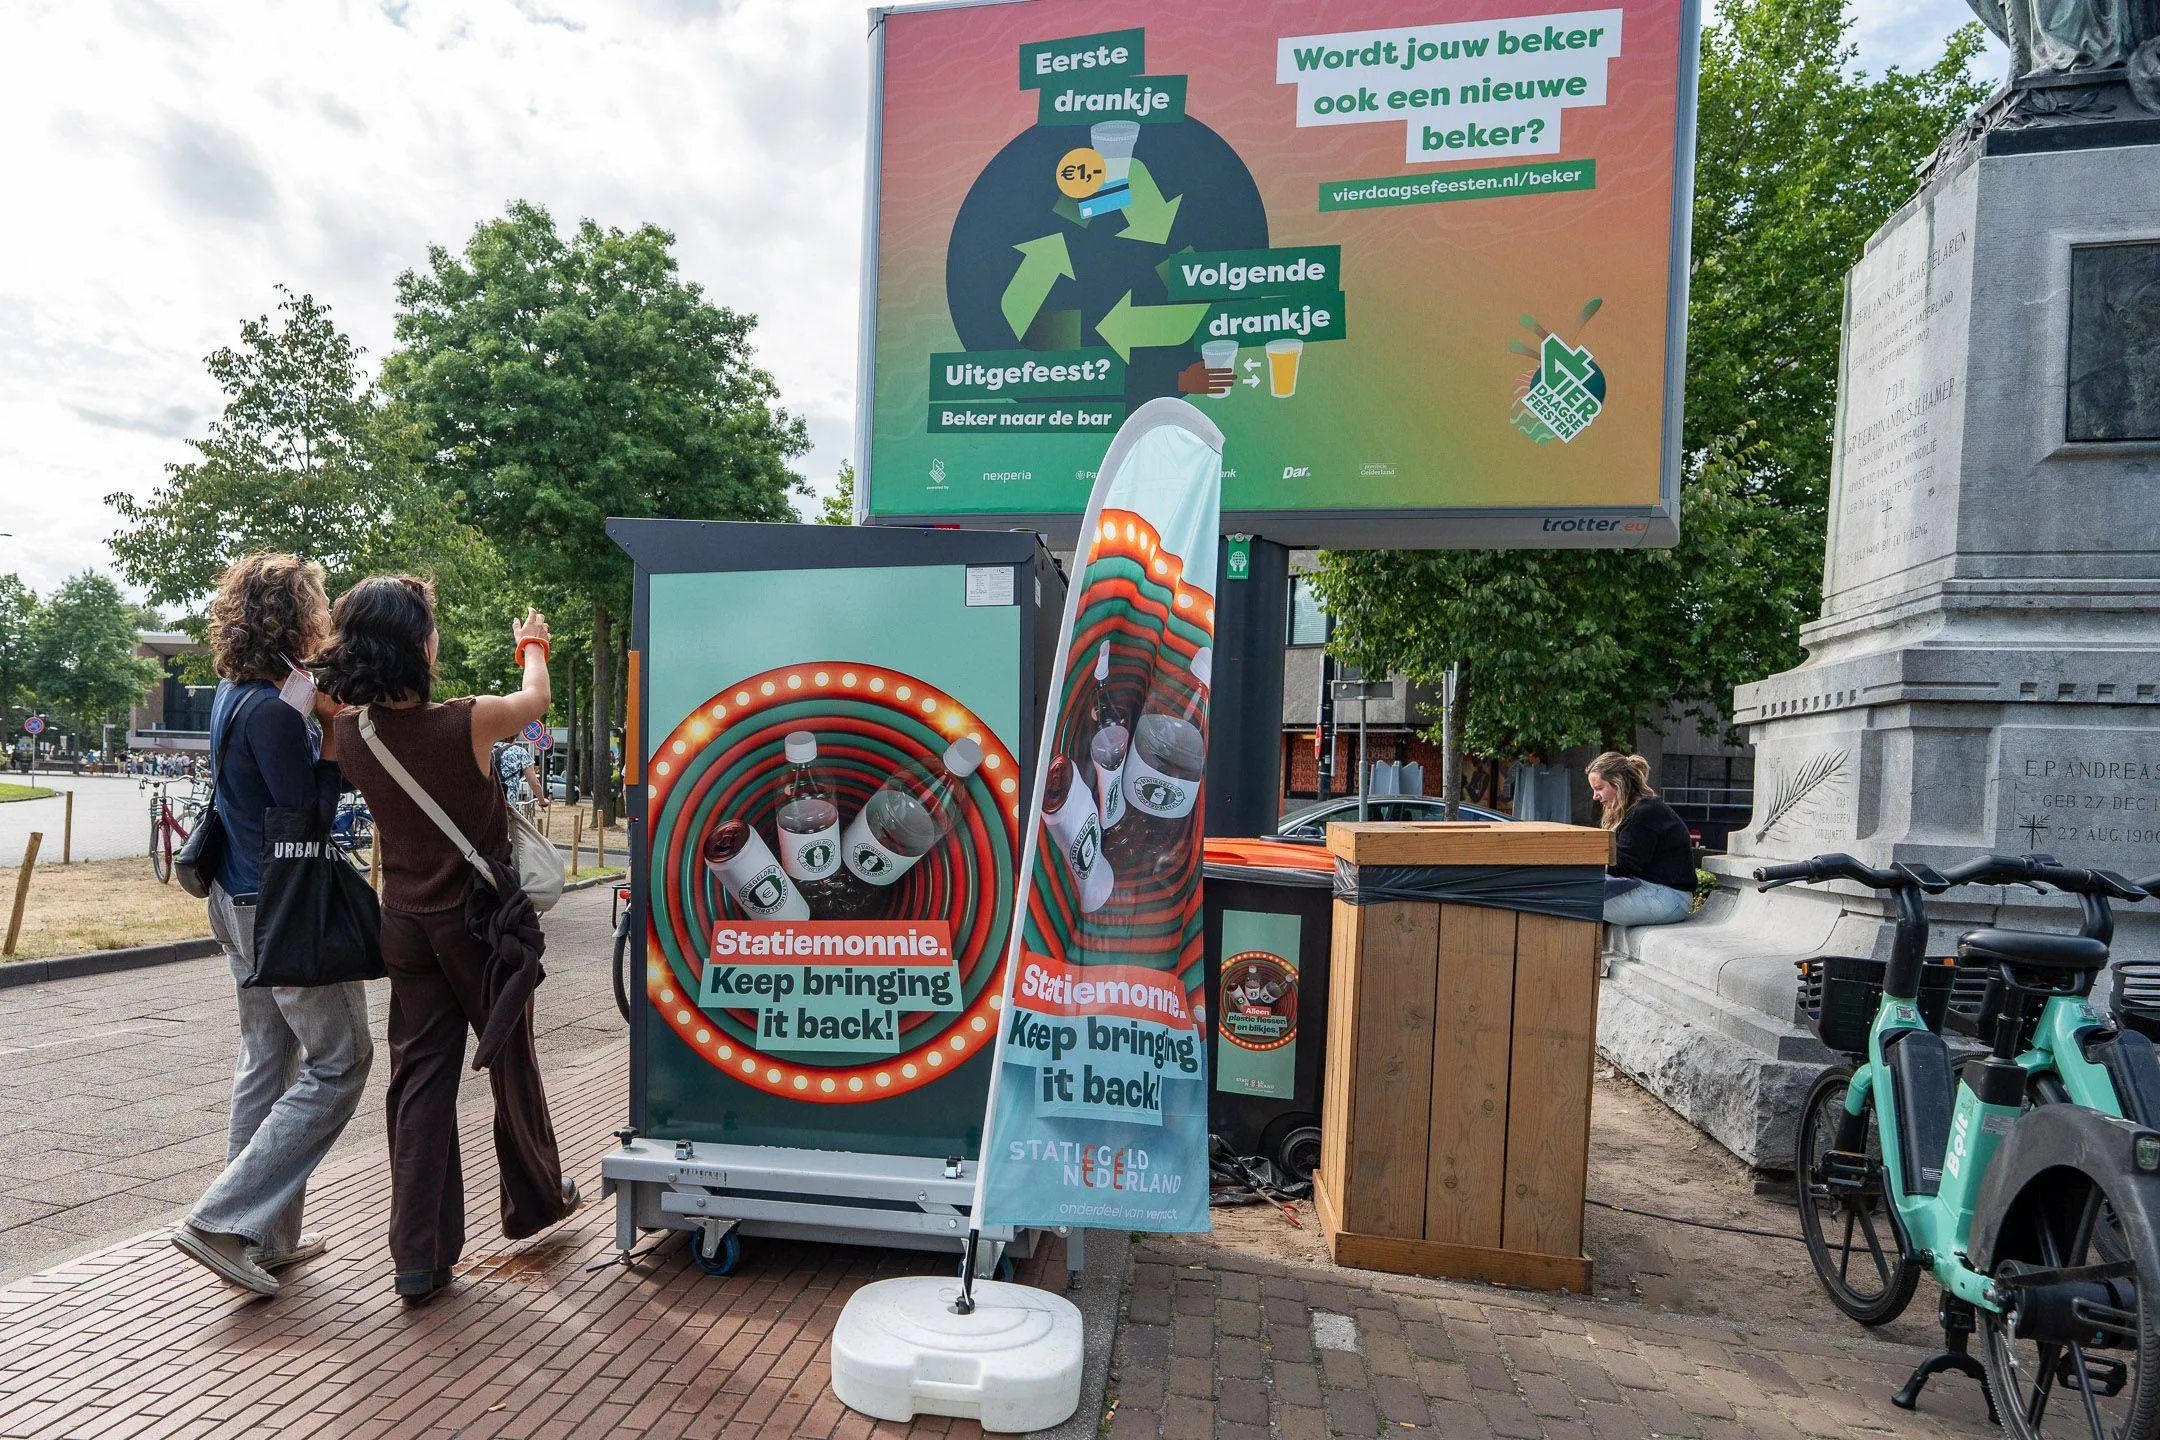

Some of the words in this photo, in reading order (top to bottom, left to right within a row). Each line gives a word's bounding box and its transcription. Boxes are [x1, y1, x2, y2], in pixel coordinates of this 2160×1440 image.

[1035, 45, 1129, 75] Eerste
[1293, 40, 1399, 72] Wordt
[1400, 35, 1489, 70] jouw
[1498, 25, 1604, 55] beker
[1053, 89, 1170, 117] drankje
[1313, 87, 1379, 115] ook
[1387, 85, 1450, 110] een
[1459, 75, 1587, 104] nieuwe
[1422, 118, 1545, 151] beker?
[1060, 163, 1103, 184] €1,-
[1332, 167, 1582, 203] vierdaagsefeesten.nl/beker
[1181, 259, 1326, 291] Volgende
[1208, 305, 1331, 337] drankje
[945, 358, 1111, 390] Uitgefeest?
[941, 411, 997, 426] Beker
[1000, 412, 1045, 426] naar
[1049, 409, 1072, 425] de
[1077, 410, 1112, 425] bar
[1526, 393, 1574, 440] FEESTEN
[1535, 384, 1583, 431] DAAGSE
[982, 470, 1032, 483] nexperia
[2058, 827, 2077, 840] 22
[716, 929, 947, 956] Statiemonnie.
[711, 967, 794, 1002] Keep
[803, 966, 953, 1005] bringing
[763, 1008, 788, 1038] it
[797, 1009, 894, 1041] back!
[1228, 1014, 1255, 1023] plastic
[1257, 1015, 1286, 1025] flessen
[1245, 1007, 1270, 1016] Alleen
[1008, 1010, 1077, 1060] Keep
[1087, 1016, 1198, 1073] bringing
[1249, 1024, 1279, 1034] blikjes.
[1043, 1067, 1074, 1102] it
[1083, 1065, 1161, 1111] back!
[1009, 1140, 1149, 1170] STATIEGELD
[1063, 1158, 1182, 1195] NEDERLAND
[1059, 1202, 1121, 1217] onderdeel
[1124, 1208, 1144, 1219] van
